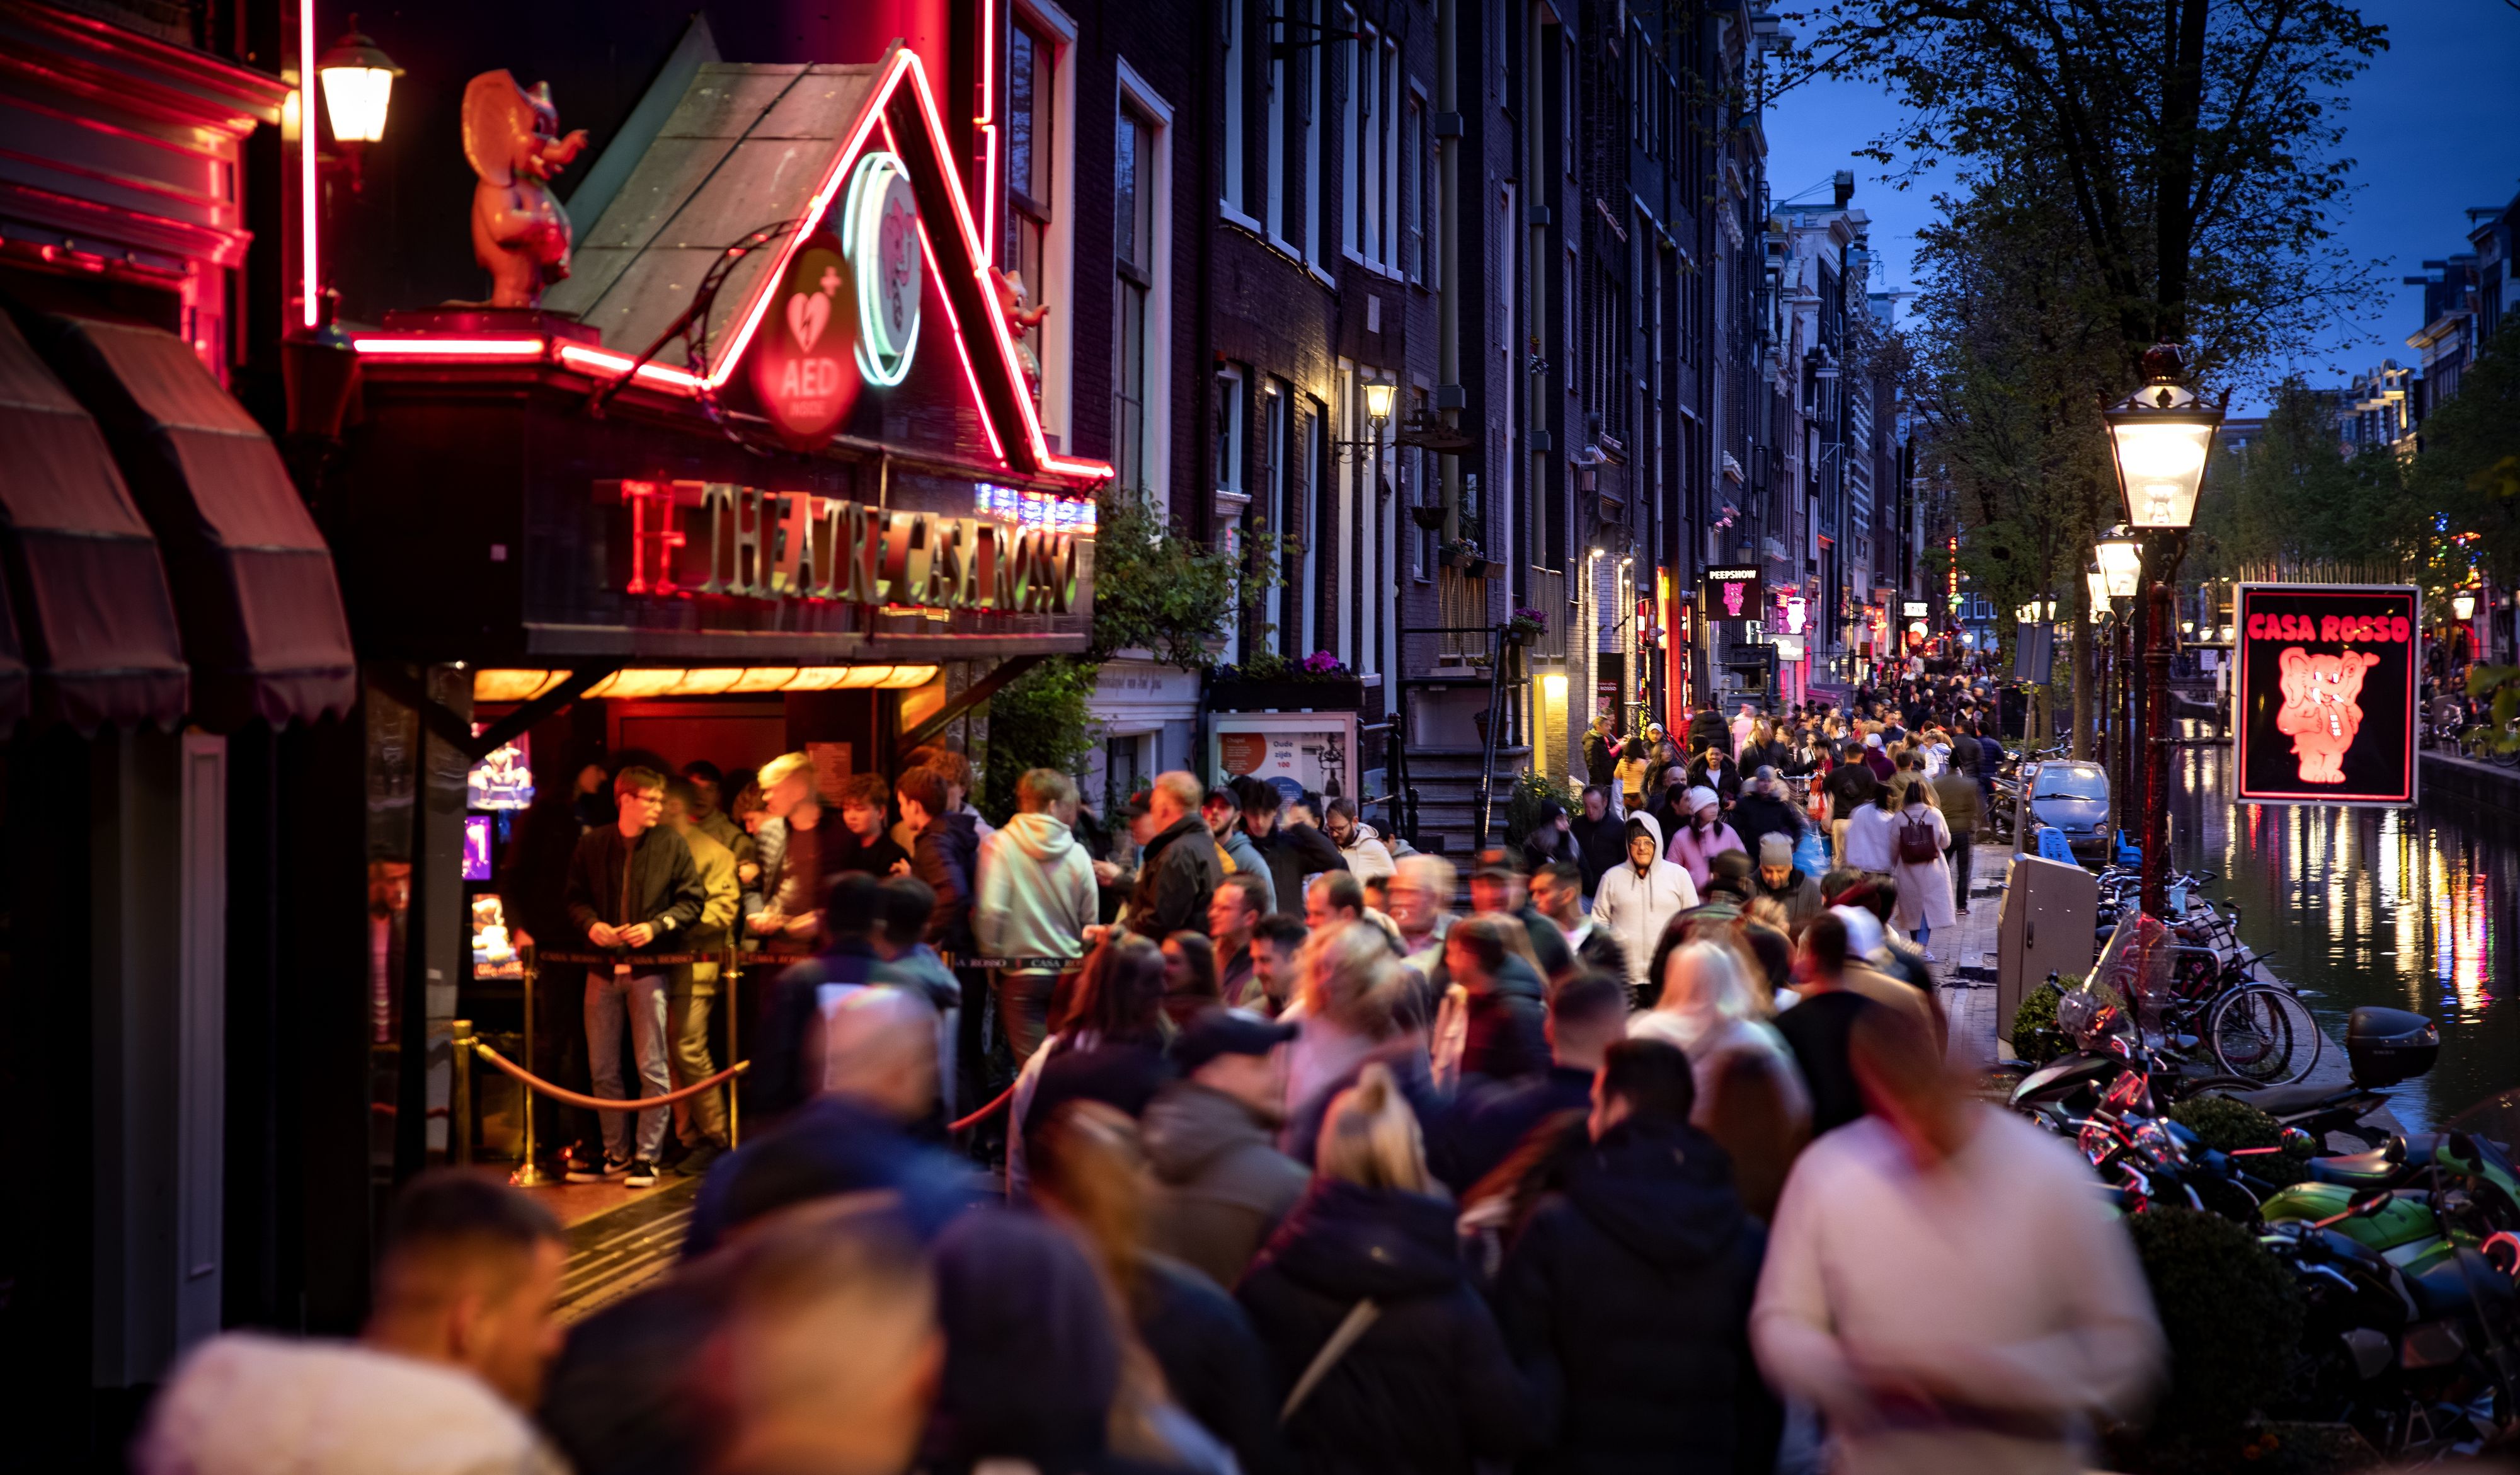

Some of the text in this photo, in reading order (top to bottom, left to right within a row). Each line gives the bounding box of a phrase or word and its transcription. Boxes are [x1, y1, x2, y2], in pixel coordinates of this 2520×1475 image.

[781, 358, 840, 397] AED
[701, 482, 891, 605] THEATRE
[905, 512, 980, 609] CASA
[992, 524, 1077, 614] ROSSO
[1709, 570, 1756, 580] PEEPSHOW
[2247, 613, 2411, 643] CASA ROSSO
[970, 958, 1007, 968] ROSSO
[1031, 958, 1060, 968] CASA
